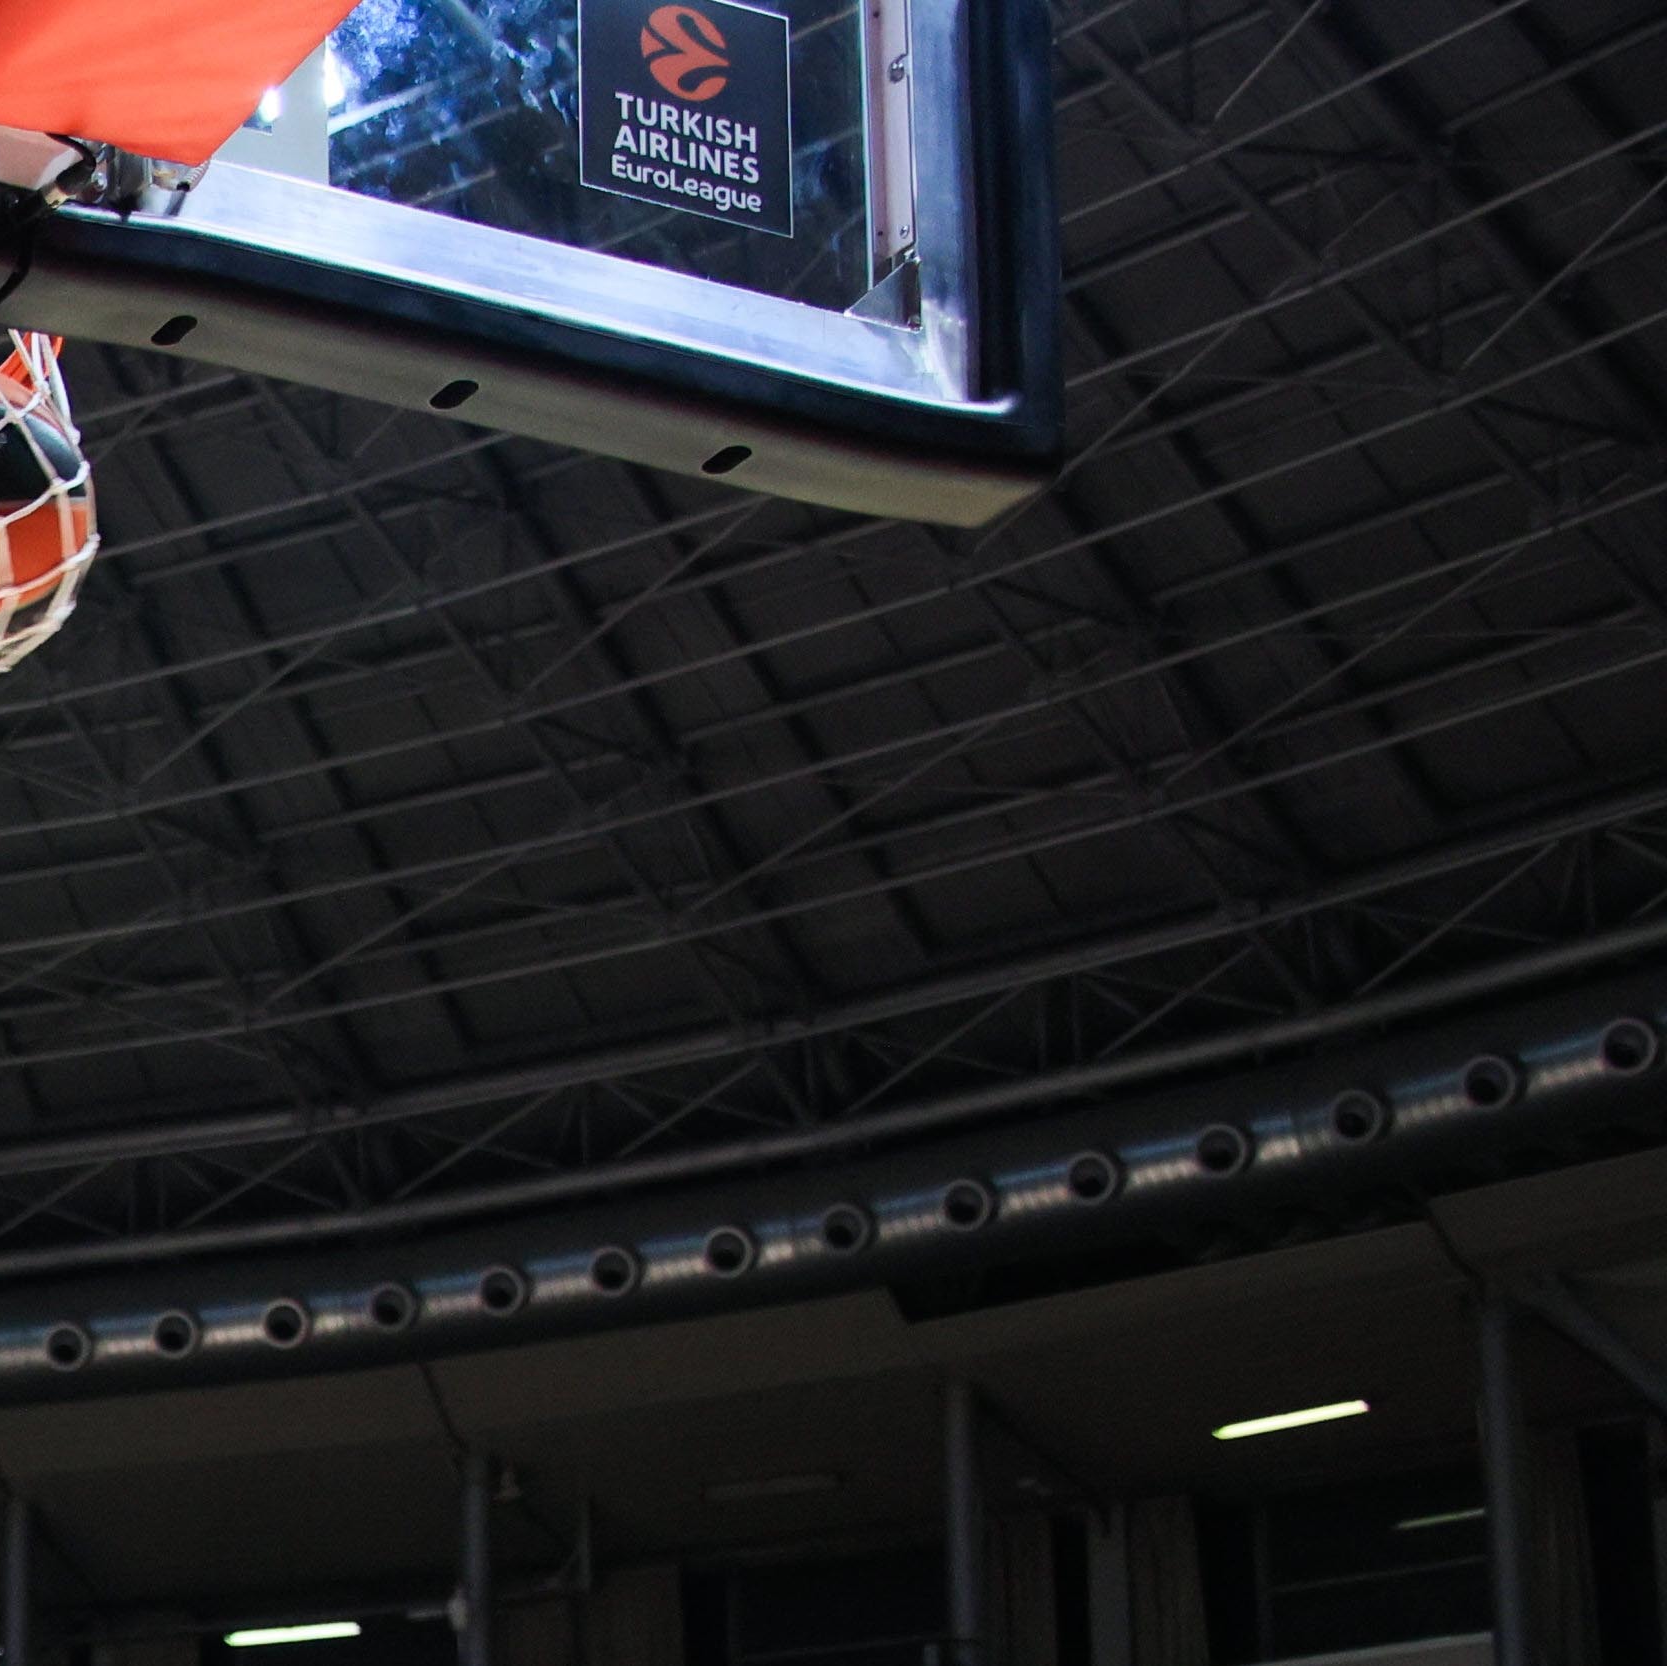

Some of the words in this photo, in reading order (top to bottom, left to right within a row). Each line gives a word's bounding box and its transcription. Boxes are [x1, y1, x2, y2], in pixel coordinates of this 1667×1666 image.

[615, 91, 756, 153] TURKISH
[611, 154, 762, 212] EuroLeague
[614, 125, 760, 184] AIRLINES
